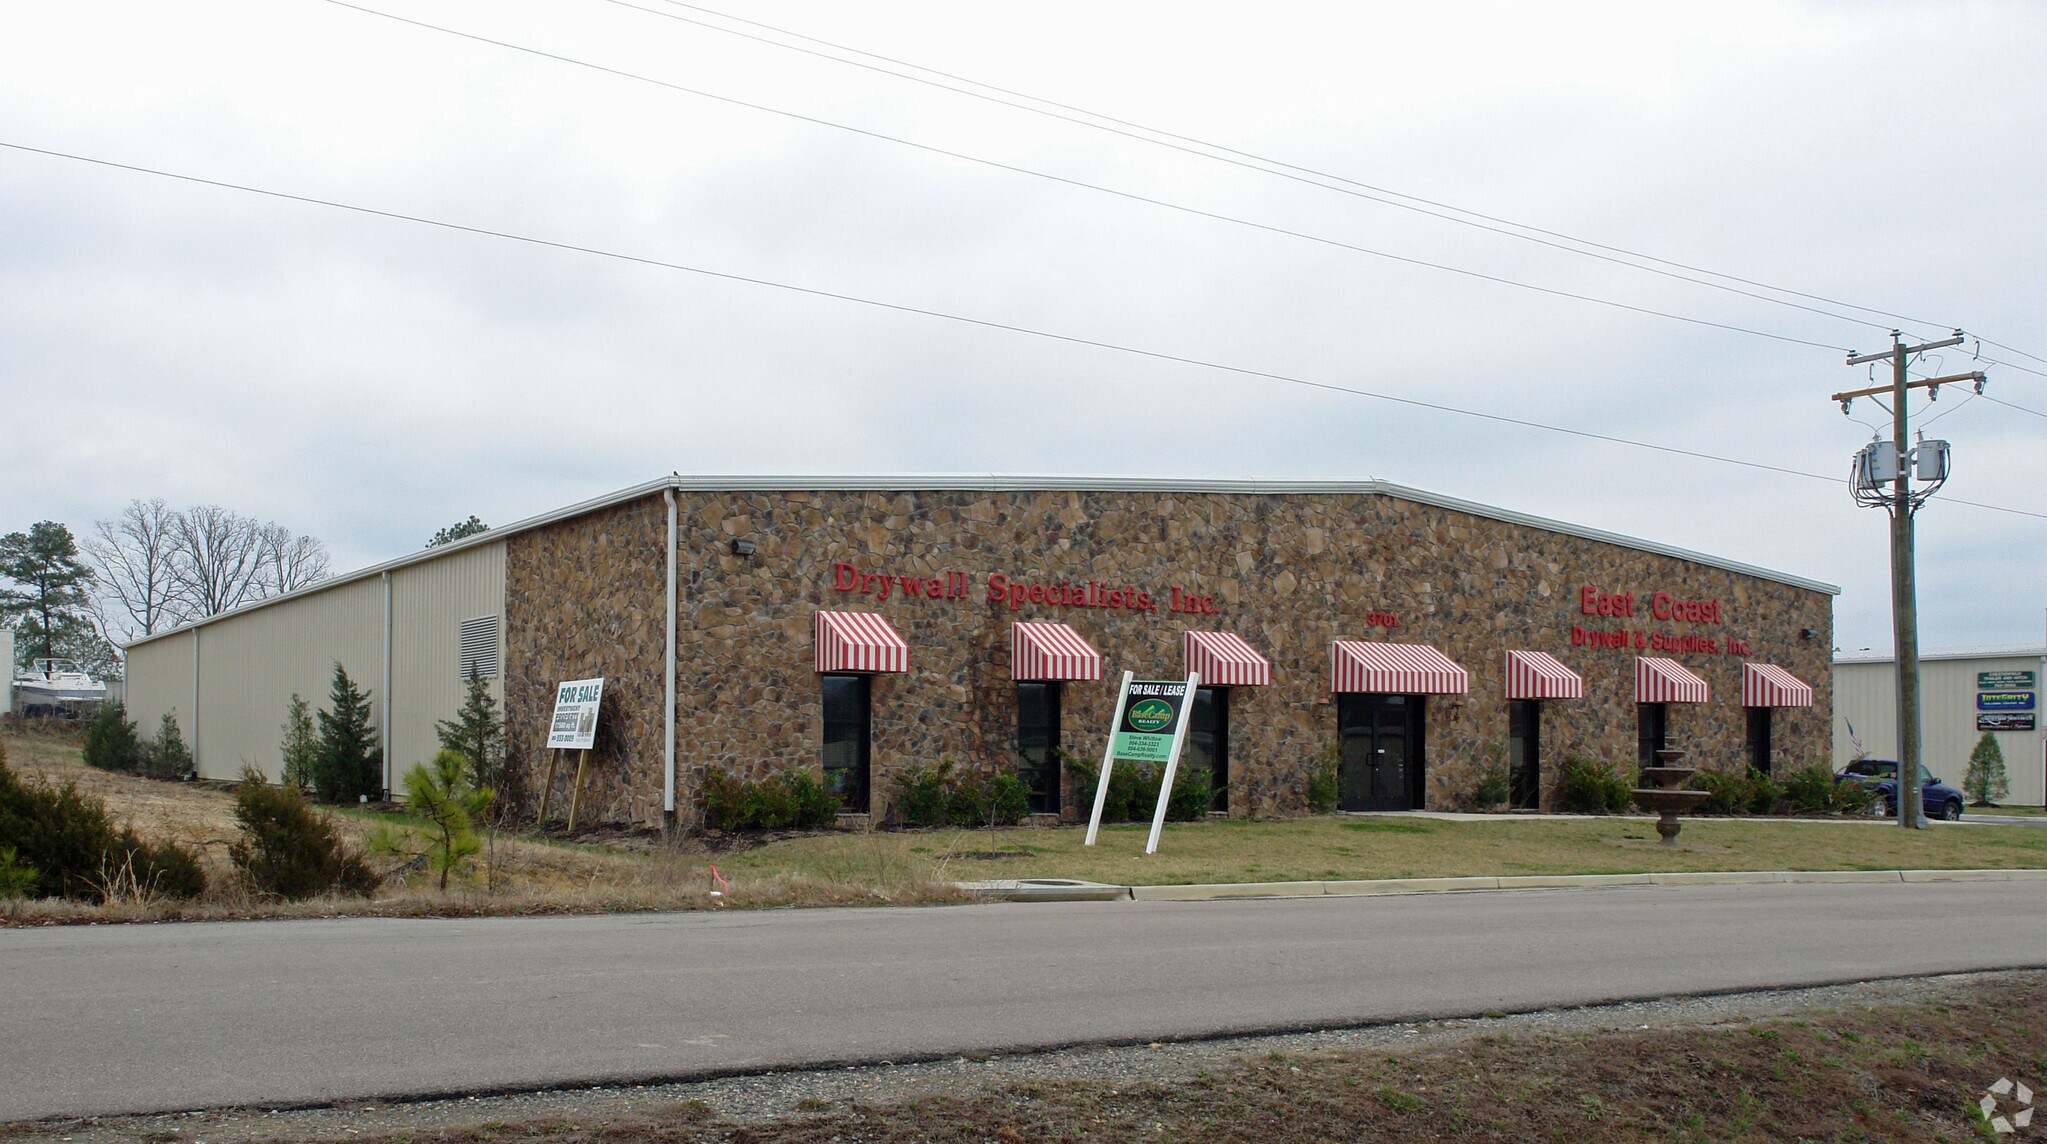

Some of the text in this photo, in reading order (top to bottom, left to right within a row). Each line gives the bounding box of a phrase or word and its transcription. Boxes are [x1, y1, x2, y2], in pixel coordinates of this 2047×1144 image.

[834, 562, 1223, 615] Drywall Specialists, Inc.
[1581, 585, 1722, 624] East Coast
[1366, 611, 1398, 628] 3701
[1571, 626, 1753, 656] Drywall & Supplies, Inc.
[559, 684, 600, 703] FOR SALE
[1129, 684, 1142, 695] FOR
[1142, 684, 1160, 695] SALE
[1164, 685, 1186, 696] LEASE
[1131, 710, 1170, 721] BaseCamp
